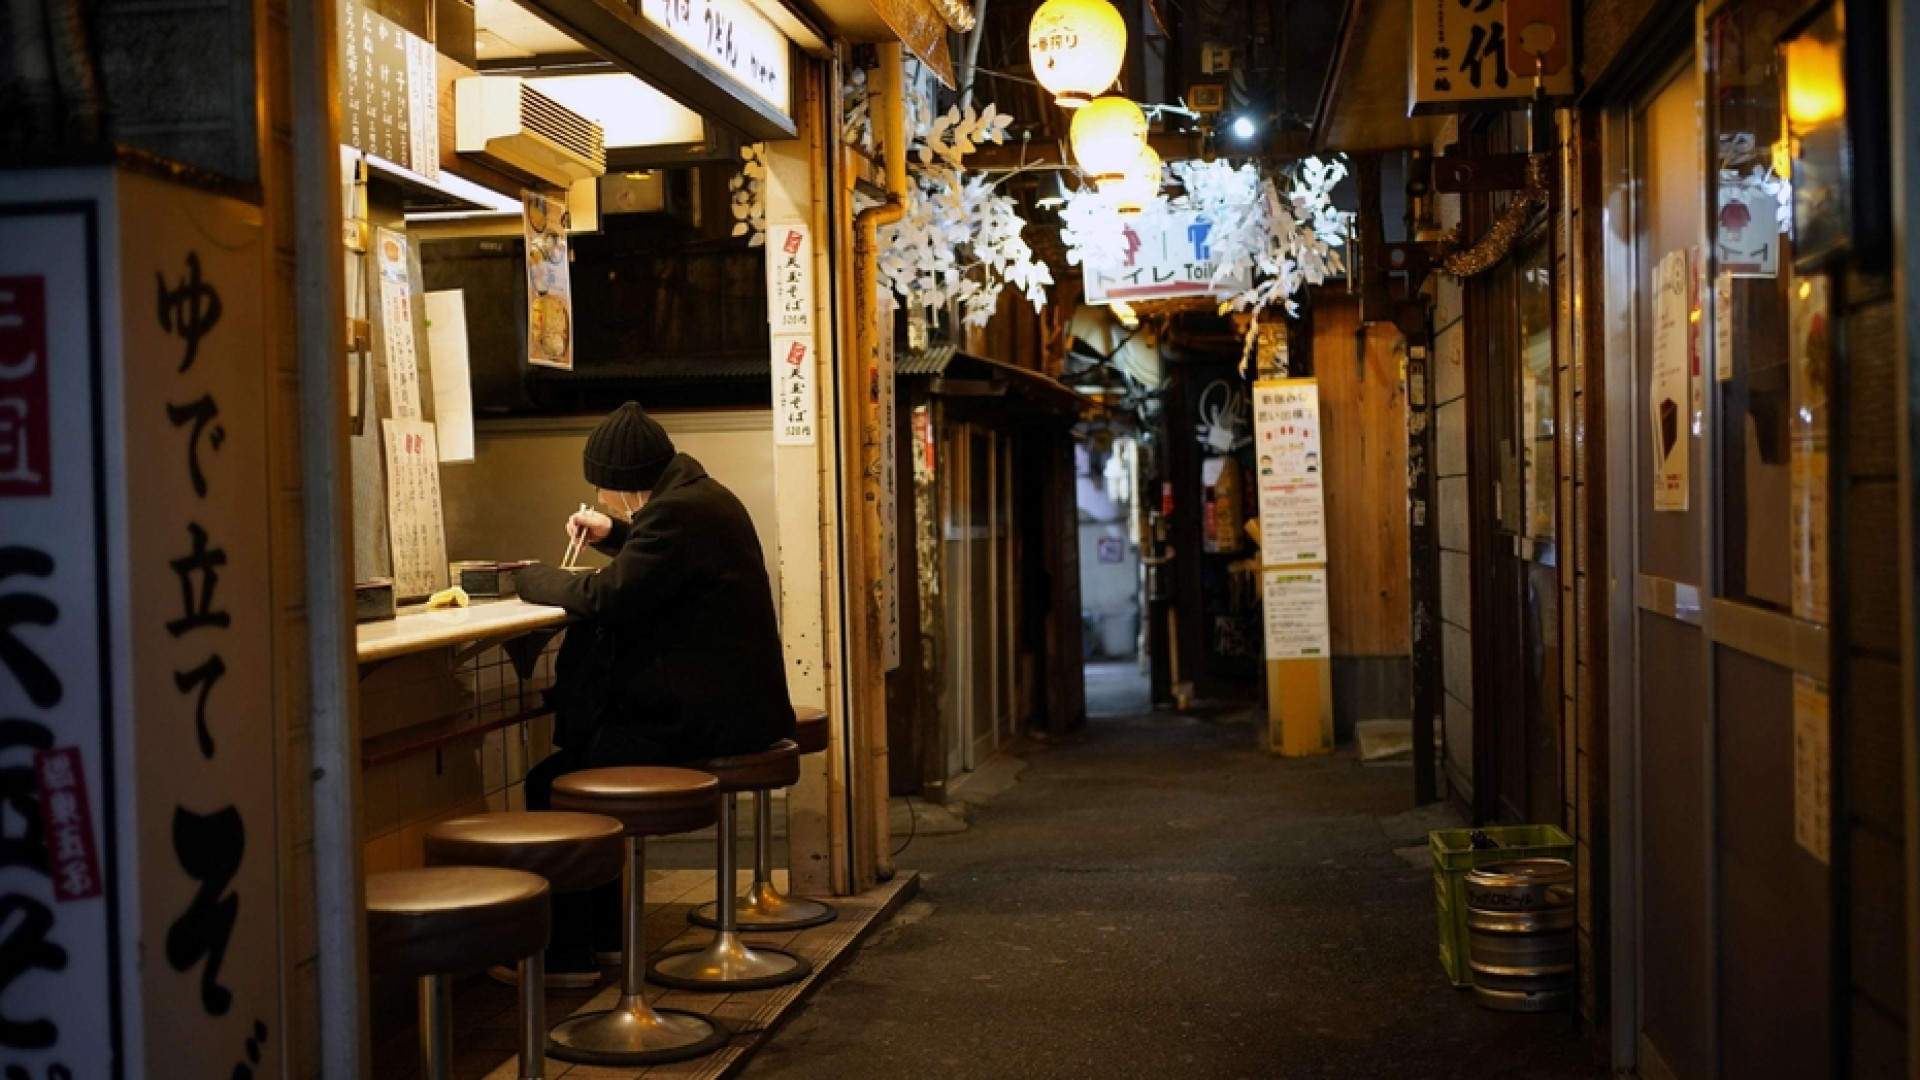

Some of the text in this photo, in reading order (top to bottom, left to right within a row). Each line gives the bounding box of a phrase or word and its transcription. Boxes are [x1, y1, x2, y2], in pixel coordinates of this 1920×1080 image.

[1459, 0, 1508, 89] 竹
[1096, 266, 1176, 287] トイレ
[156, 252, 267, 1080] ゆで立てそ
